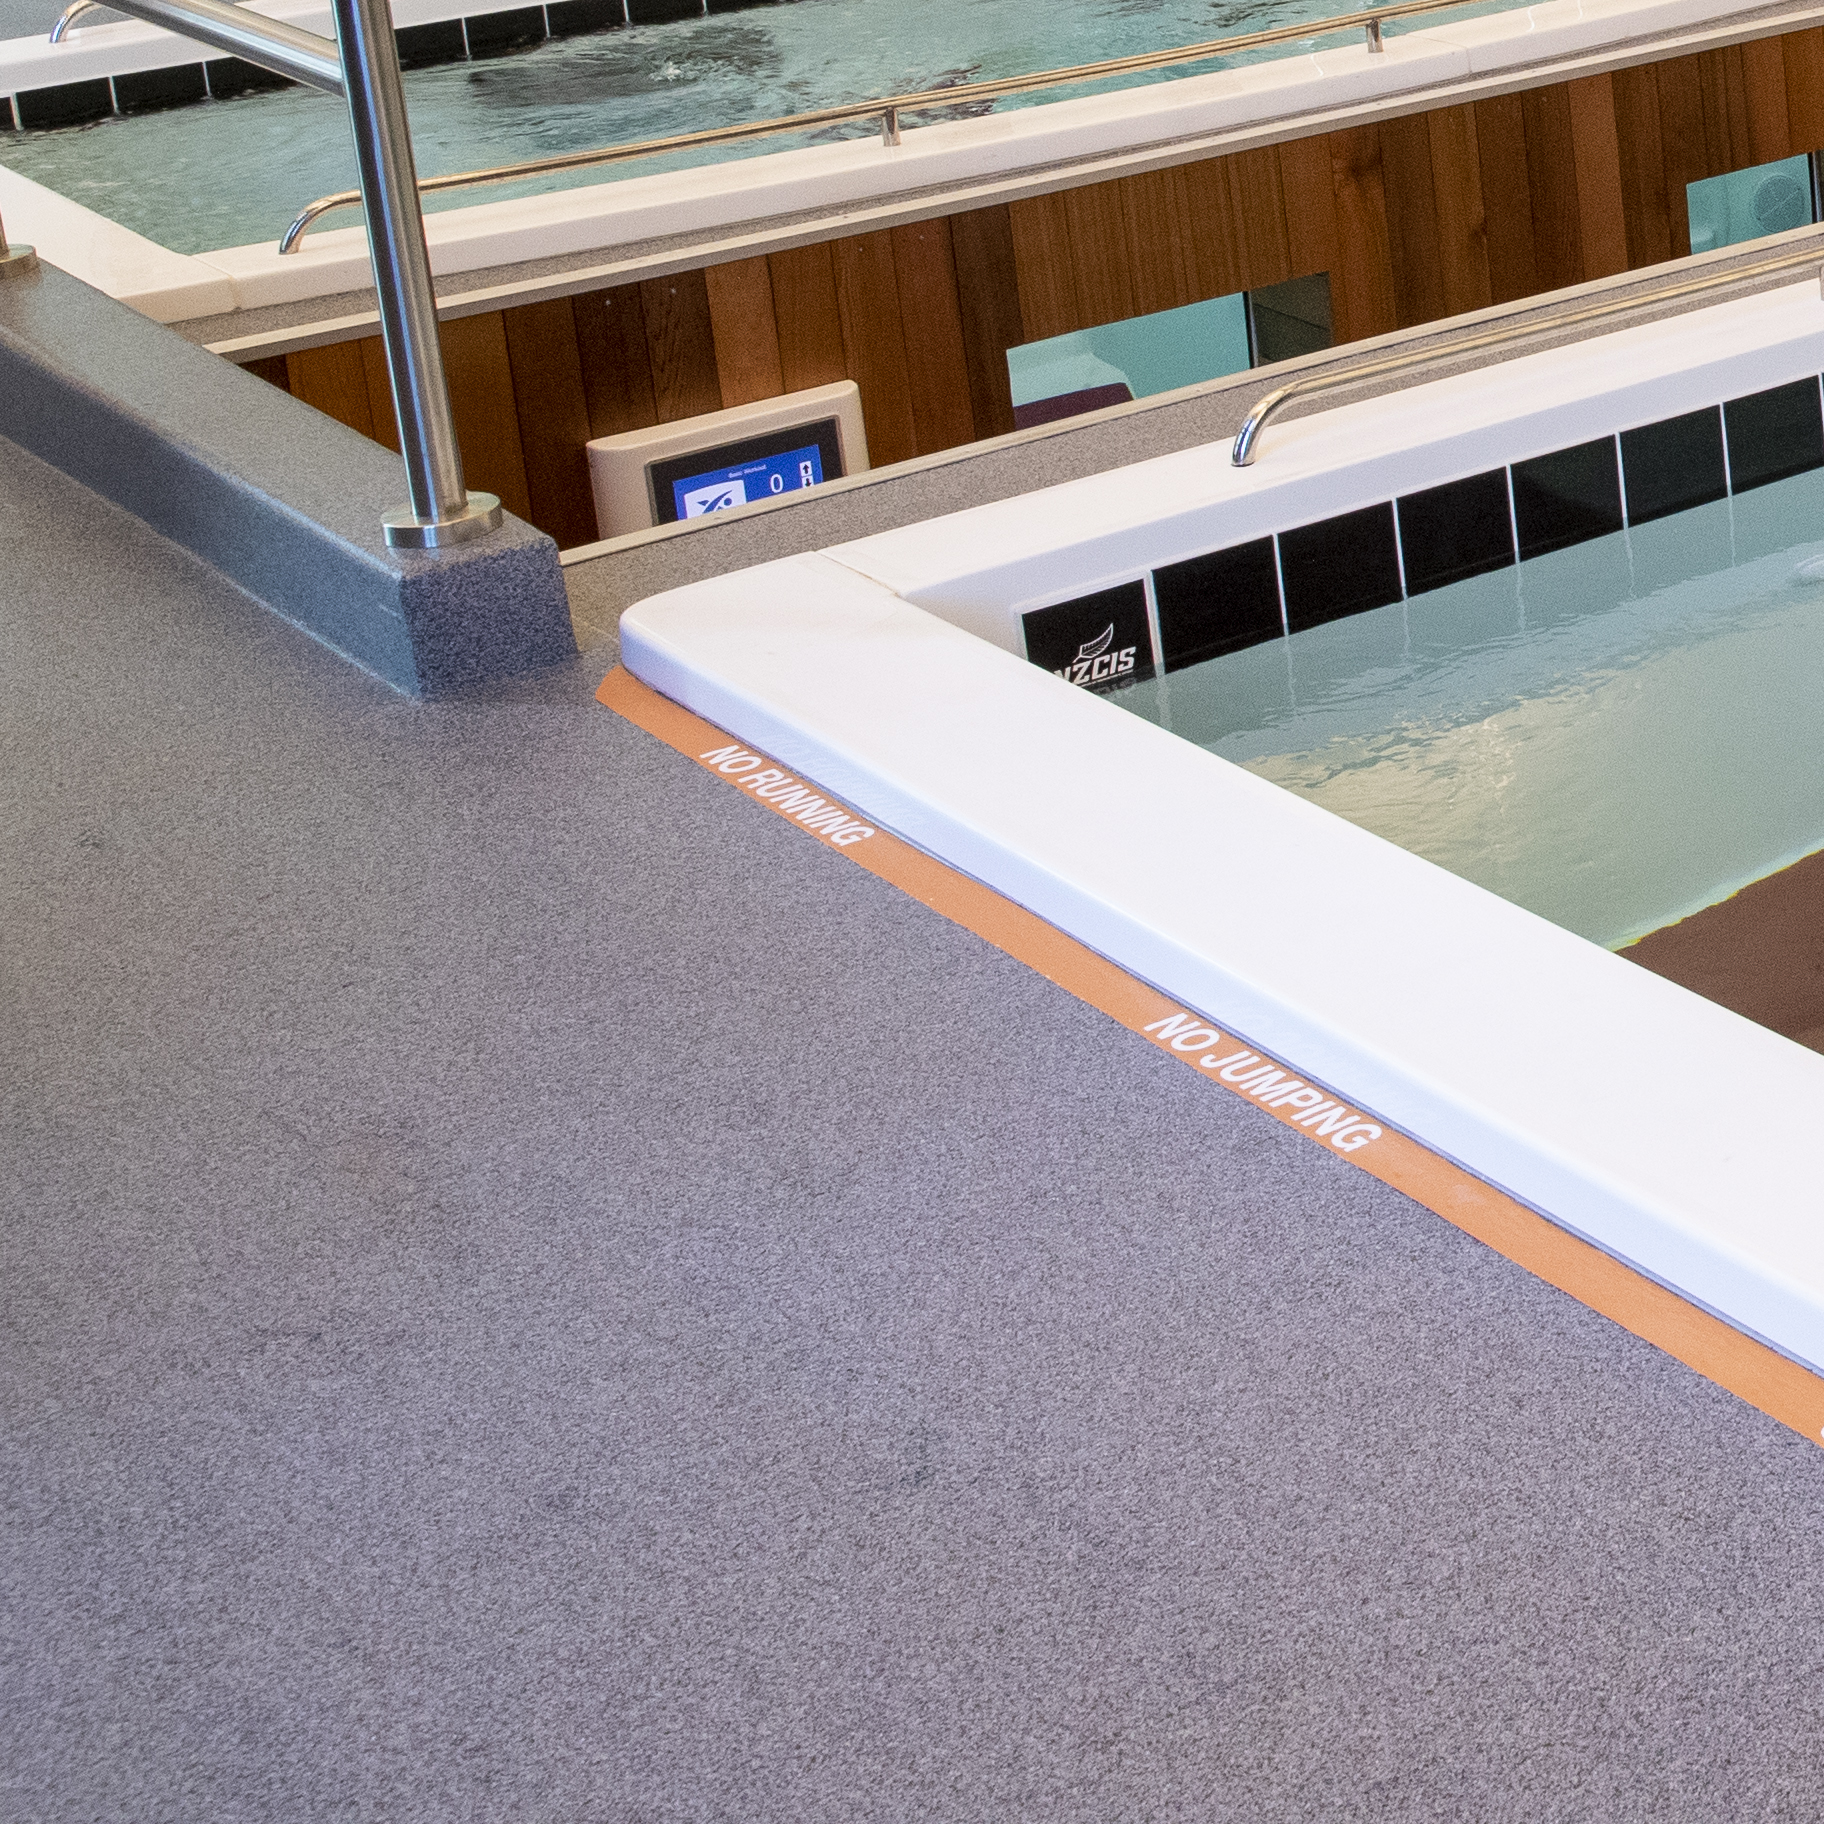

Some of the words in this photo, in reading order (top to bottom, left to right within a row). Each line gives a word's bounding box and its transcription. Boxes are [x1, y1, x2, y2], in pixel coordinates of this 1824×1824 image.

[1053, 646, 1137, 684] NZCIS
[700, 744, 743, 774] NO
[738, 769, 877, 849] RUNNING
[1143, 1012, 1204, 1052] NO
[1200, 1048, 1383, 1154] JUMPING
